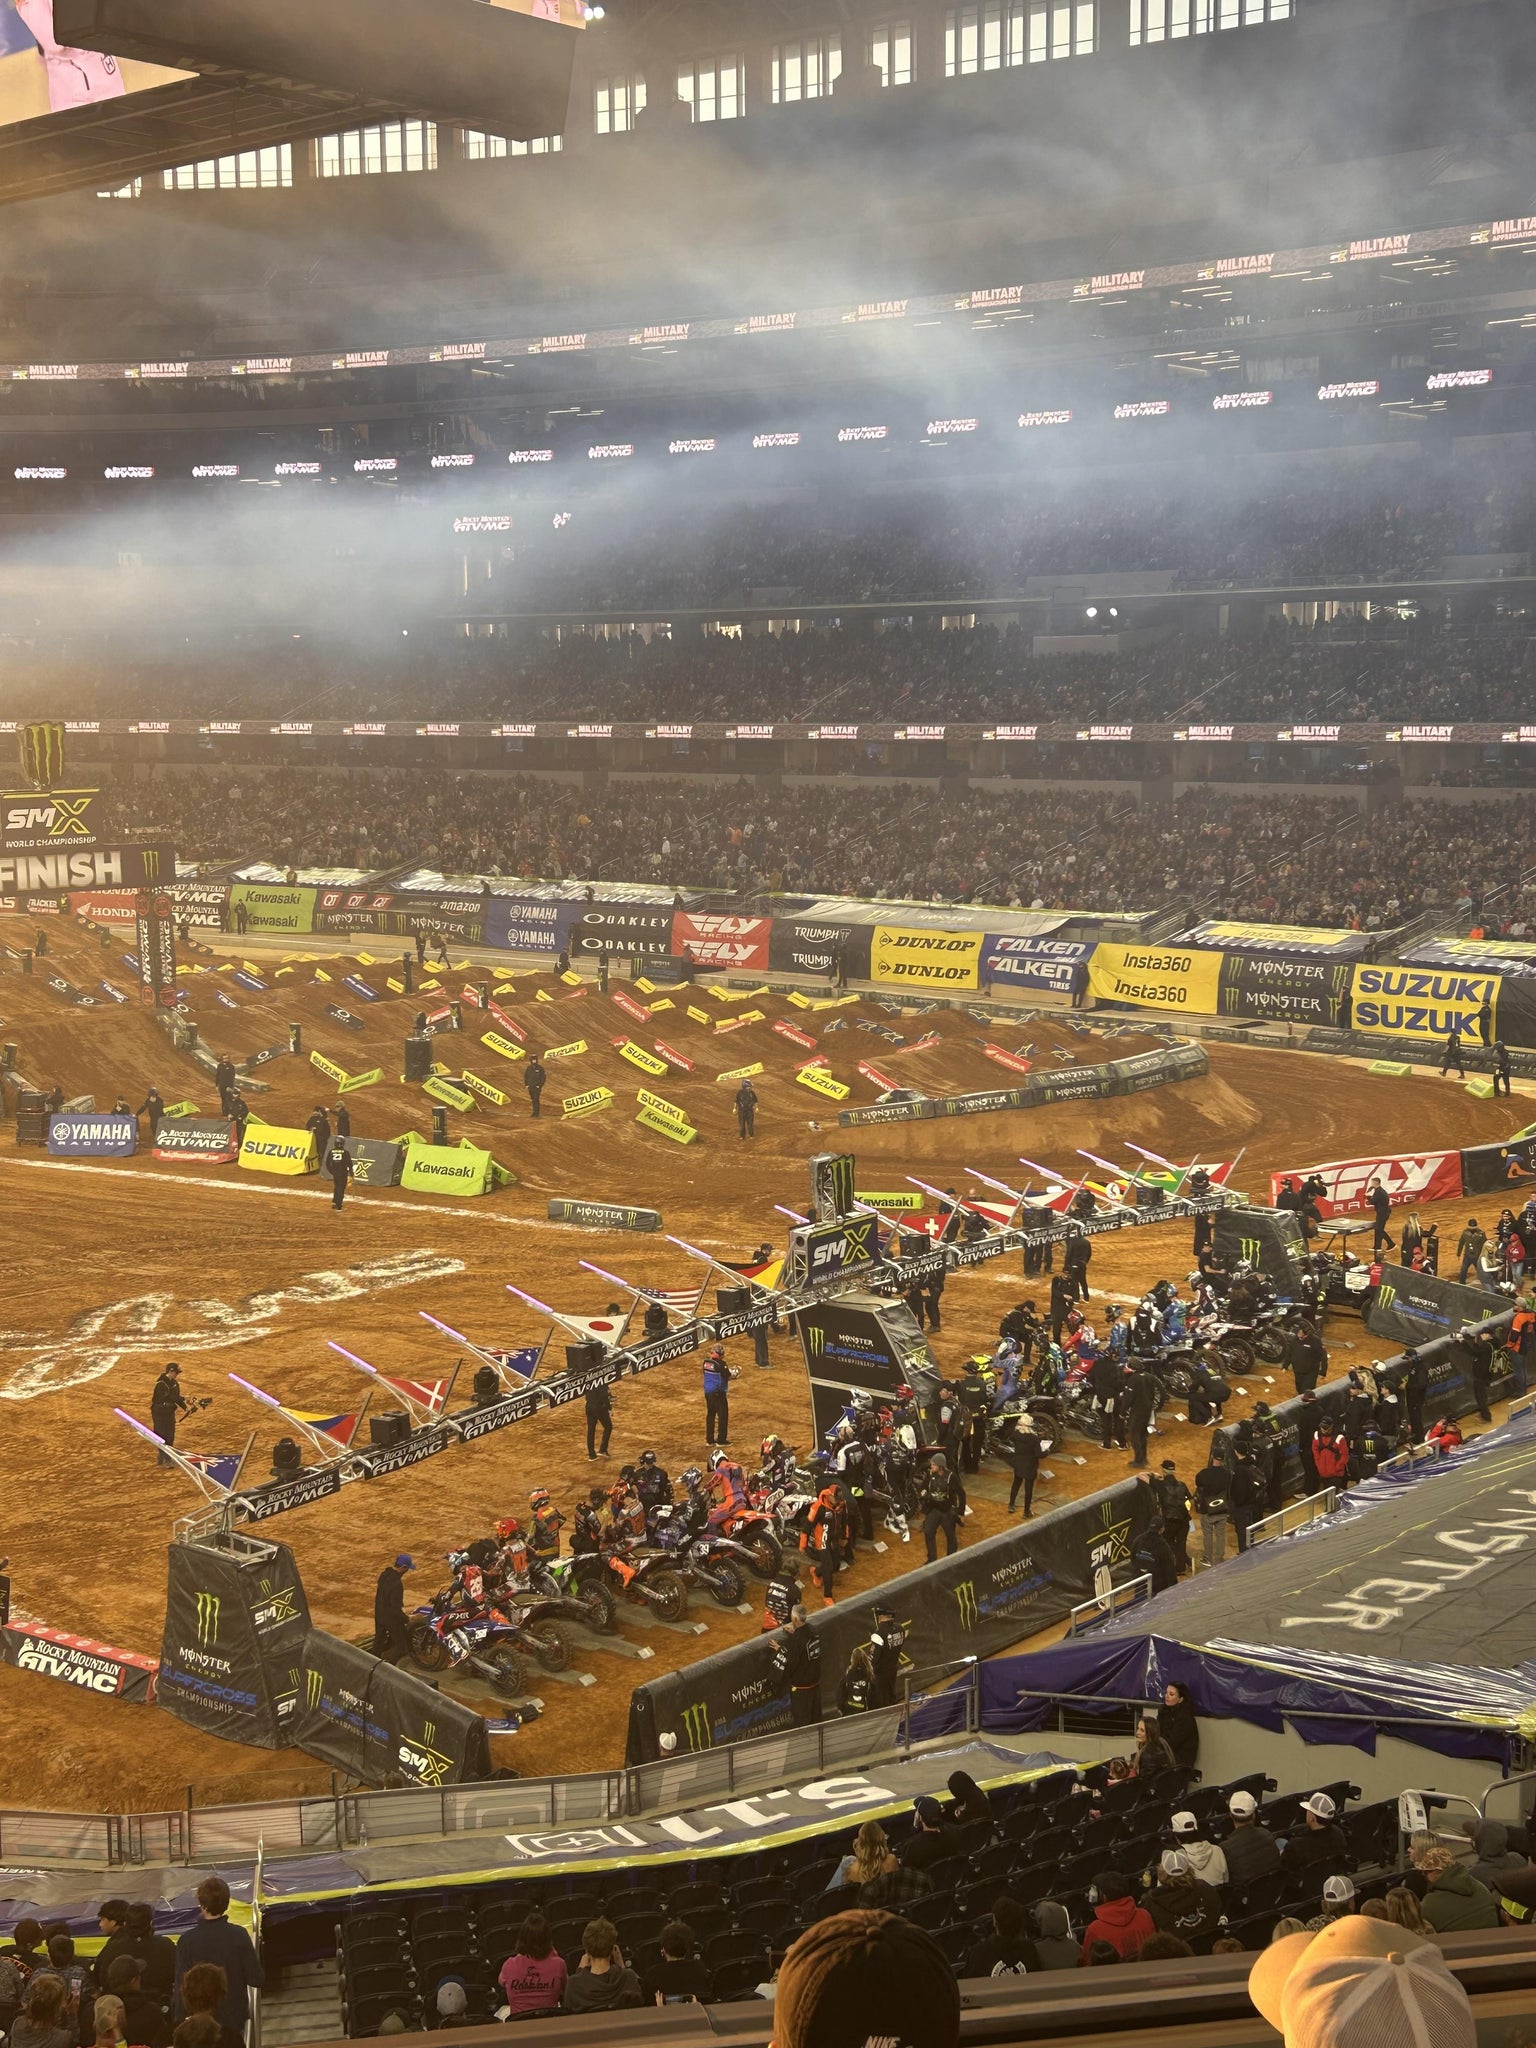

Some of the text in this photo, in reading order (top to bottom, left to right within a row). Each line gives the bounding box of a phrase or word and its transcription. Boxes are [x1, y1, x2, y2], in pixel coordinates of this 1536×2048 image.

[1350, 234, 1410, 254] MILITARY
[1216, 253, 1273, 272] MILITARY
[1091, 270, 1144, 288] MILITARY
[971, 285, 1023, 302] MILITARY
[857, 300, 908, 315] MILITARY
[749, 312, 796, 327] MILITARY
[643, 324, 689, 338] MILITARY
[543, 334, 586, 347] MILITARY
[346, 351, 388, 363] MILITARY
[443, 343, 486, 356] MILITARY
[29, 364, 79, 375] MILITARY
[140, 362, 188, 373] MILITARY
[247, 358, 292, 369] MILITARY
[353, 723, 386, 732] MILITARY
[502, 724, 536, 733] MILITARY
[657, 725, 692, 735] MILITARY
[737, 725, 773, 735] MILITARY
[820, 726, 858, 736] MILITARY
[906, 726, 945, 736] MILITARY
[996, 726, 1037, 736] MILITARY
[1090, 726, 1132, 736] MILITARY
[1188, 726, 1234, 737] MILITARY
[1293, 726, 1340, 737] MILITARY
[1402, 726, 1453, 737] MILITARY
[5, 798, 93, 836] SMX
[6, 836, 97, 849] WORLD CHAMPIONSHIP
[0, 851, 122, 893] FINISH
[246, 890, 302, 905] Kawasaki
[323, 894, 338, 907] QT
[347, 895, 364, 907] QT
[372, 896, 391, 908] QT
[440, 900, 481, 913] amazon
[520, 906, 557, 921] YAMAHA
[328, 913, 373, 925] MONSTER
[410, 917, 465, 933] MONSTER
[606, 914, 669, 928] OAKLEY
[687, 914, 763, 935] FLY
[519, 929, 555, 946] YAMAHA
[795, 927, 838, 939] TRIUMPH
[605, 939, 667, 953] OAKLEY
[683, 939, 759, 960] FLY
[893, 936, 976, 954] DUNLOP
[995, 937, 1086, 957] FALKEN
[698, 958, 742, 967] RACING
[987, 956, 1073, 982] FALKEN
[1123, 952, 1192, 974] Insta360
[1249, 960, 1324, 981] MONSTER
[892, 963, 971, 982] DUNLOP
[1049, 981, 1071, 990] TIRES
[1258, 978, 1310, 987] ENERGY
[1359, 970, 1495, 1003] SUZUKI
[1114, 980, 1187, 1003] Insta360
[1246, 991, 1321, 1012] MONSTER
[1257, 1010, 1309, 1021] ENERGY
[498, 1018, 524, 1041] HONDA
[783, 1027, 810, 1048] HONDA
[486, 1034, 521, 1056] SUZUKI
[546, 1045, 580, 1058] SUZUKI
[624, 1048, 661, 1071] SUZUKI
[661, 1050, 691, 1071] HONDA
[996, 1054, 1026, 1072] HONDA
[312, 1056, 343, 1083] SUZUKI
[1050, 1069, 1094, 1082] MONSTER
[342, 1072, 375, 1091] Kawasaki
[464, 1074, 502, 1102] SUZUKI
[802, 1073, 844, 1095] SUZUKI
[430, 1080, 467, 1106] Kawasaki
[565, 1091, 602, 1111] SUZUKI
[640, 1094, 681, 1120] SUZUKI
[959, 1095, 1007, 1110] MONSTER
[862, 1106, 909, 1121] MONSTER
[71, 1124, 131, 1142] YAMAHA
[644, 1111, 690, 1138] Kawasaki
[169, 1129, 229, 1140] ROCKY MOUNTAIN
[56, 1140, 126, 1148] RACING
[244, 1140, 306, 1160] SUZUKI
[413, 1160, 476, 1180] Kawasaki
[1333, 1195, 1416, 1213] RACNG
[577, 1206, 623, 1221] MONSTER
[813, 1223, 872, 1268] SMX
[747, 1306, 774, 1322] MOUNTAIN
[646, 1335, 694, 1359] ROCKY MOUNTAIN
[838, 1333, 873, 1347] MONSTER
[564, 1363, 616, 1391] ROCKY MOUNTAIN
[475, 1398, 531, 1426] ROCKY MOUNTAIN
[384, 1430, 442, 1462] ROCKY MOUNTAIN
[268, 1473, 334, 1504] ROCKY MOUNTAIN
[699, 1544, 710, 1556] 39
[1090, 1526, 1131, 1569] SMX
[991, 1556, 1034, 1584] MONSTER
[254, 1592, 299, 1627] SMX
[35, 1639, 121, 1677] ROCKY MOUNTAIN
[179, 1646, 232, 1674] MONSTER
[161, 1663, 257, 1708] SUPERCROSS
[176, 1685, 234, 1715] CHAMPIONSHIP
[865, 2035, 901, 2048] NIKE
